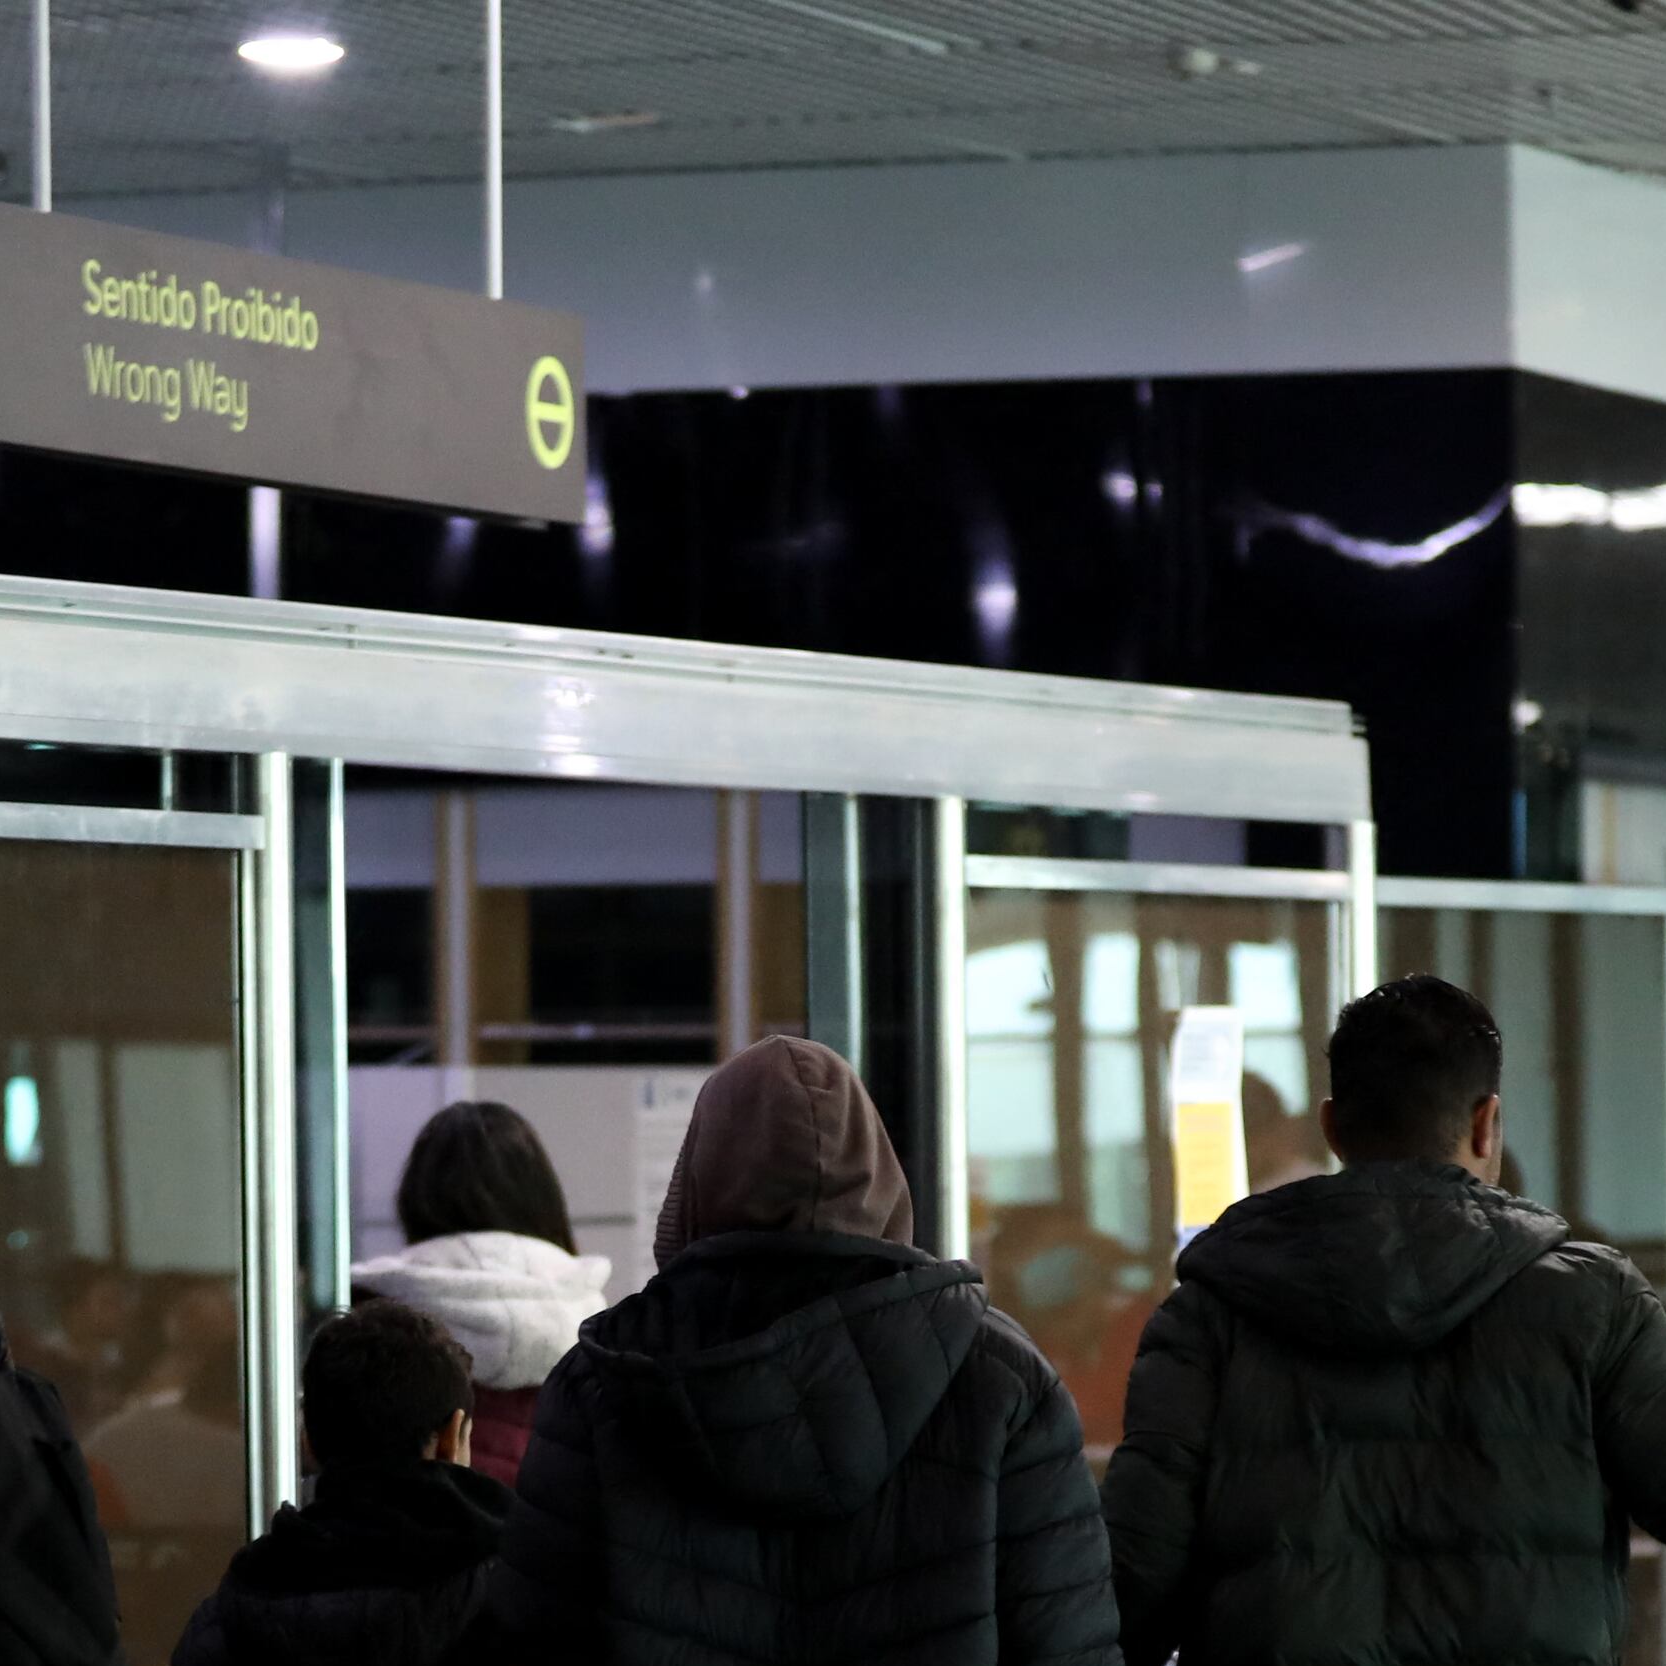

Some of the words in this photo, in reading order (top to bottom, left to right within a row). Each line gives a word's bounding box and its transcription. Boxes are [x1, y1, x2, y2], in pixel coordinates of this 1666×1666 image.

[82, 258, 197, 331] Sentido
[201, 280, 319, 351] Proibido
[85, 342, 182, 423] Wrong
[186, 357, 249, 433] Way
